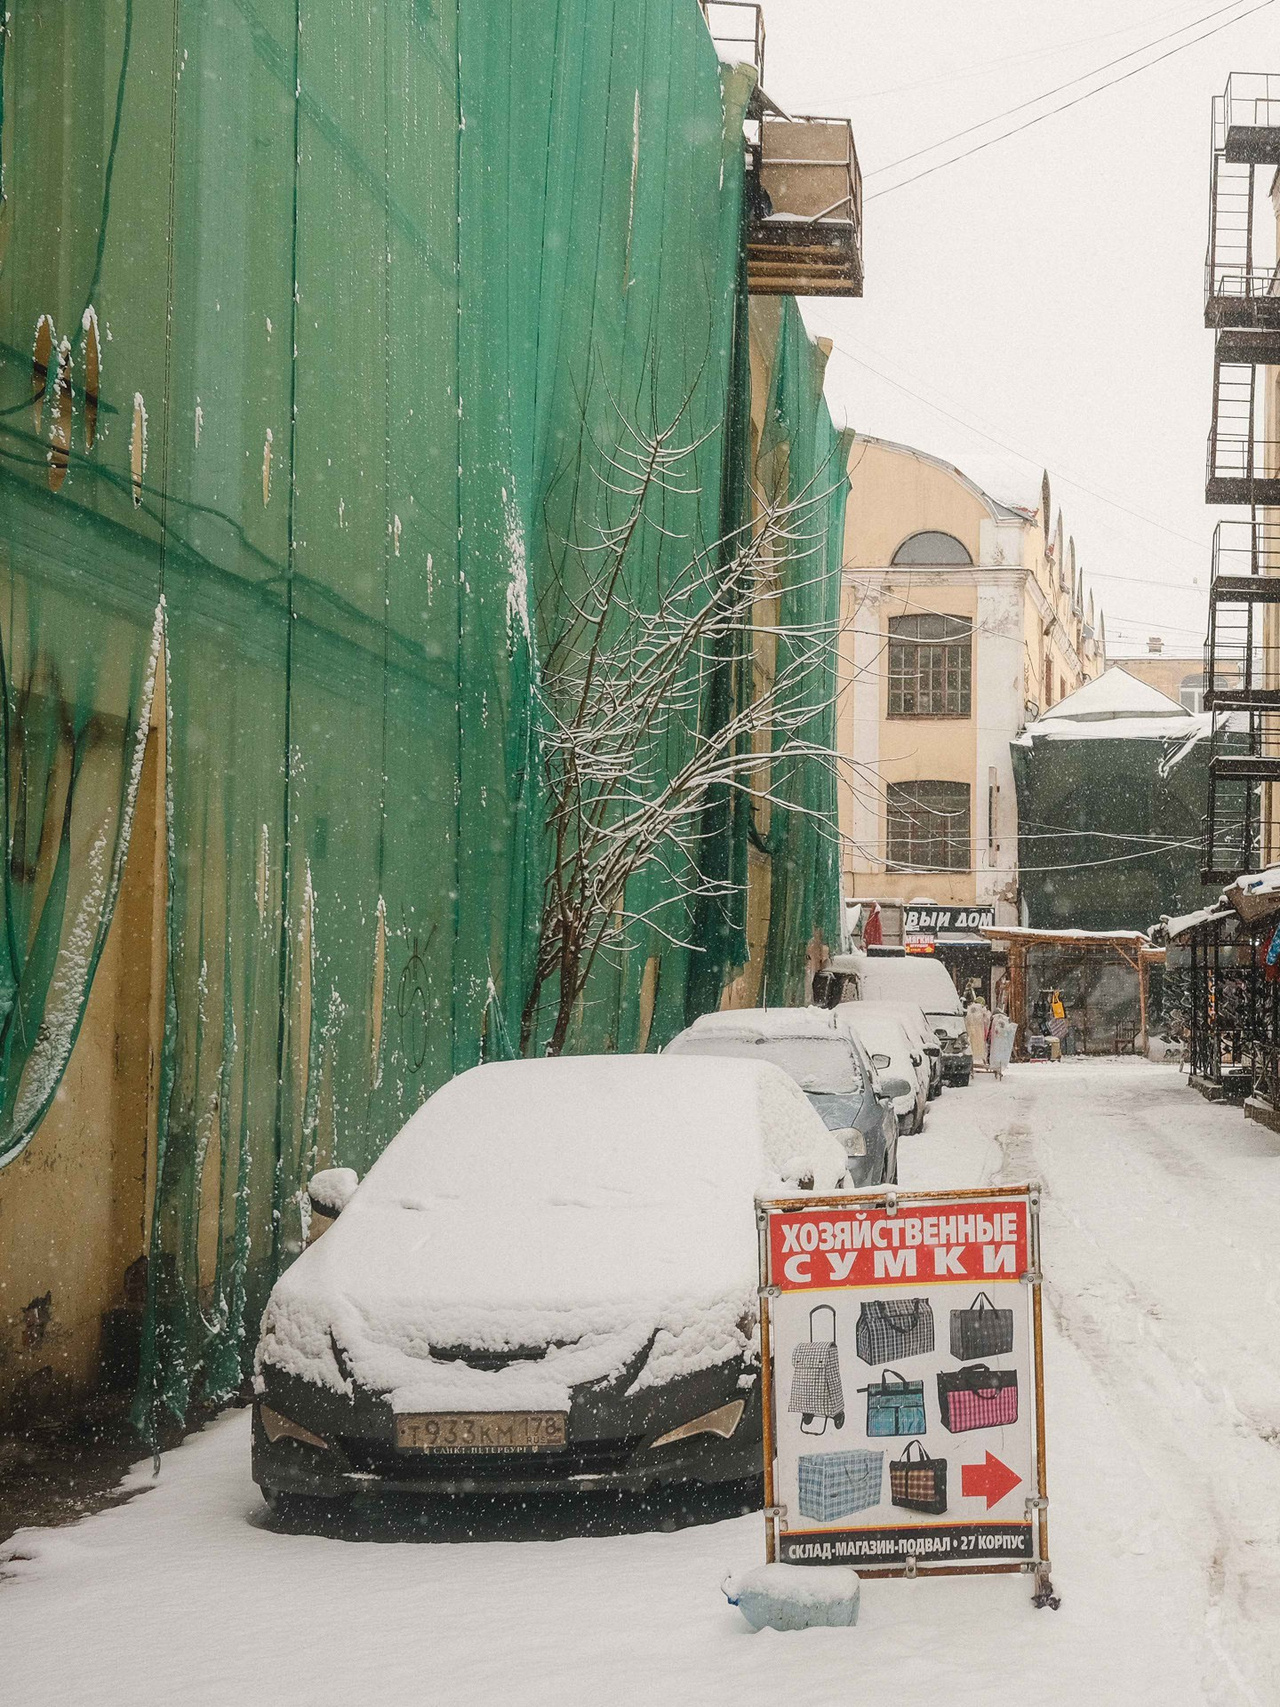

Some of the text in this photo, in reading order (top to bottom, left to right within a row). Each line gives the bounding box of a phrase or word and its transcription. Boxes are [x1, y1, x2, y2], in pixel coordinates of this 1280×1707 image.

[955, 912, 993, 927] ДОМ
[781, 1213, 1018, 1253] ХОЗЯЙСТВЕННЫЕ
[784, 1244, 1016, 1283] СУМКИ
[523, 1417, 557, 1436] 178
[527, 1436, 545, 1444] RUS
[960, 1535, 976, 1550] 27
[978, 1534, 1025, 1550] КОРПУС
